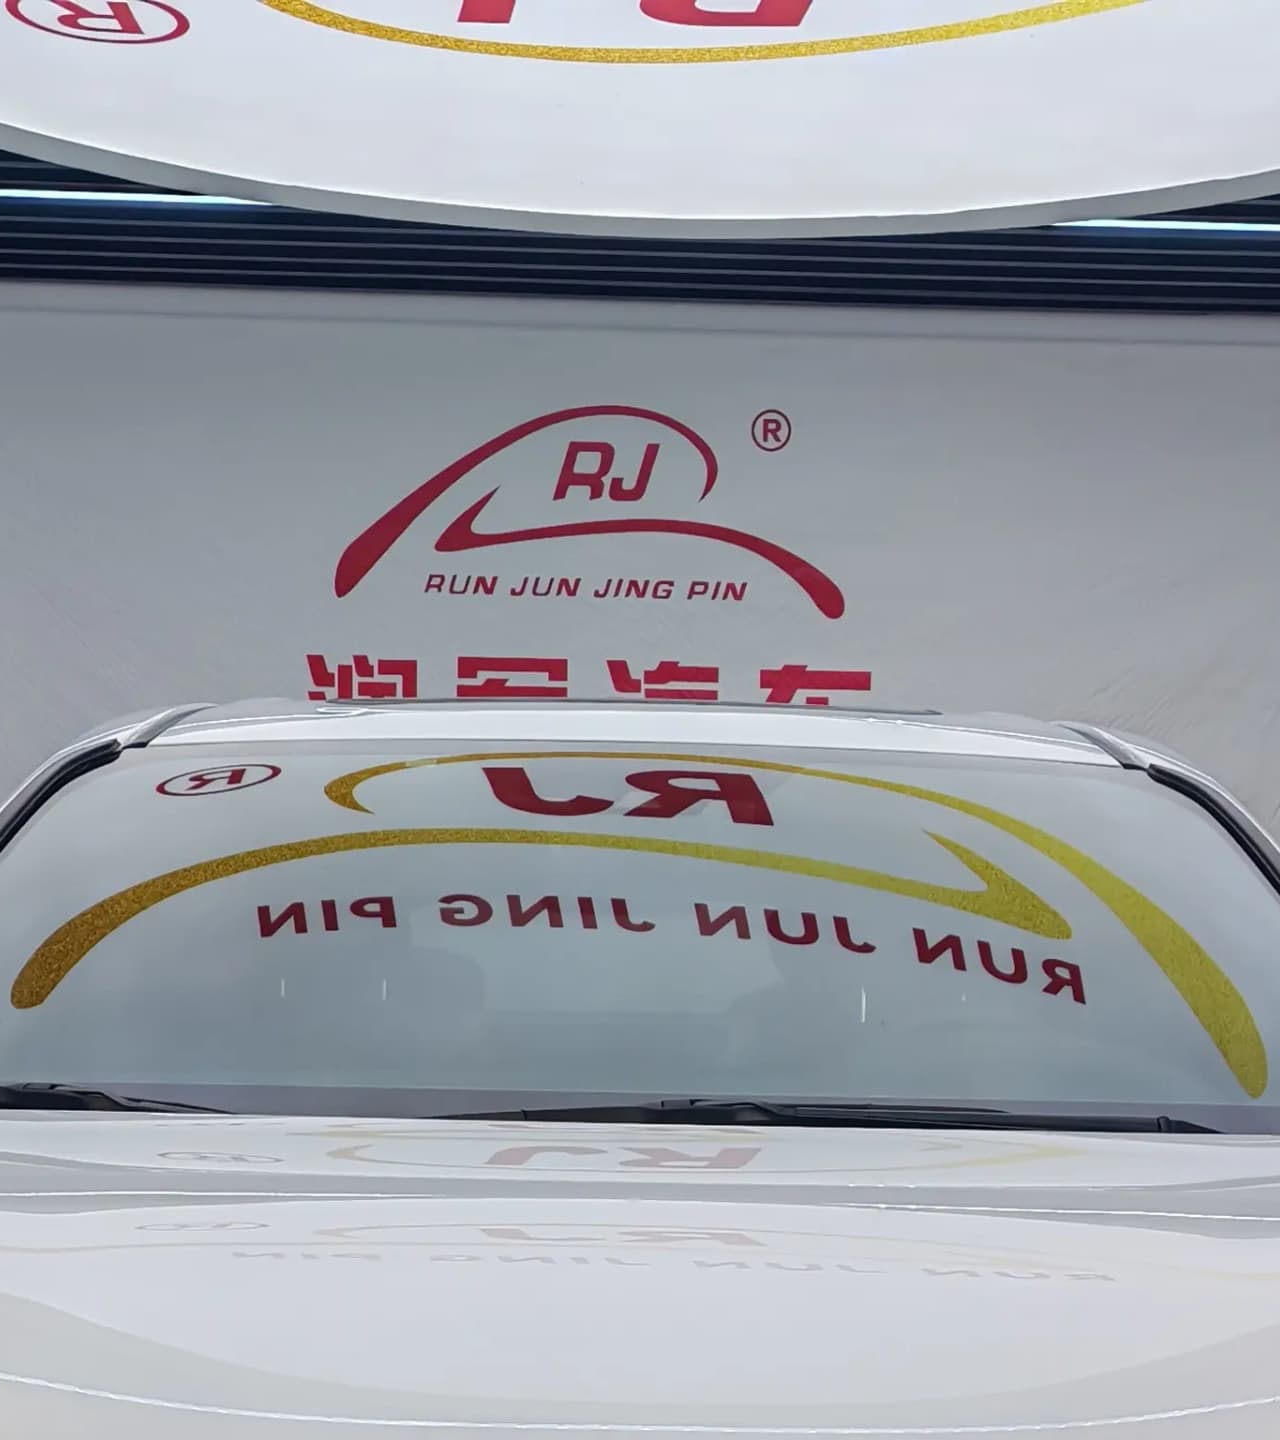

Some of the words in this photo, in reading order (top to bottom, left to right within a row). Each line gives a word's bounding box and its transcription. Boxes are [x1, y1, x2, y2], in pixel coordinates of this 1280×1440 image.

[552, 441, 660, 502] RJ
[424, 574, 498, 596] RUN
[509, 577, 581, 598] JUN
[593, 579, 675, 601] JING
[687, 581, 748, 602] PIN
